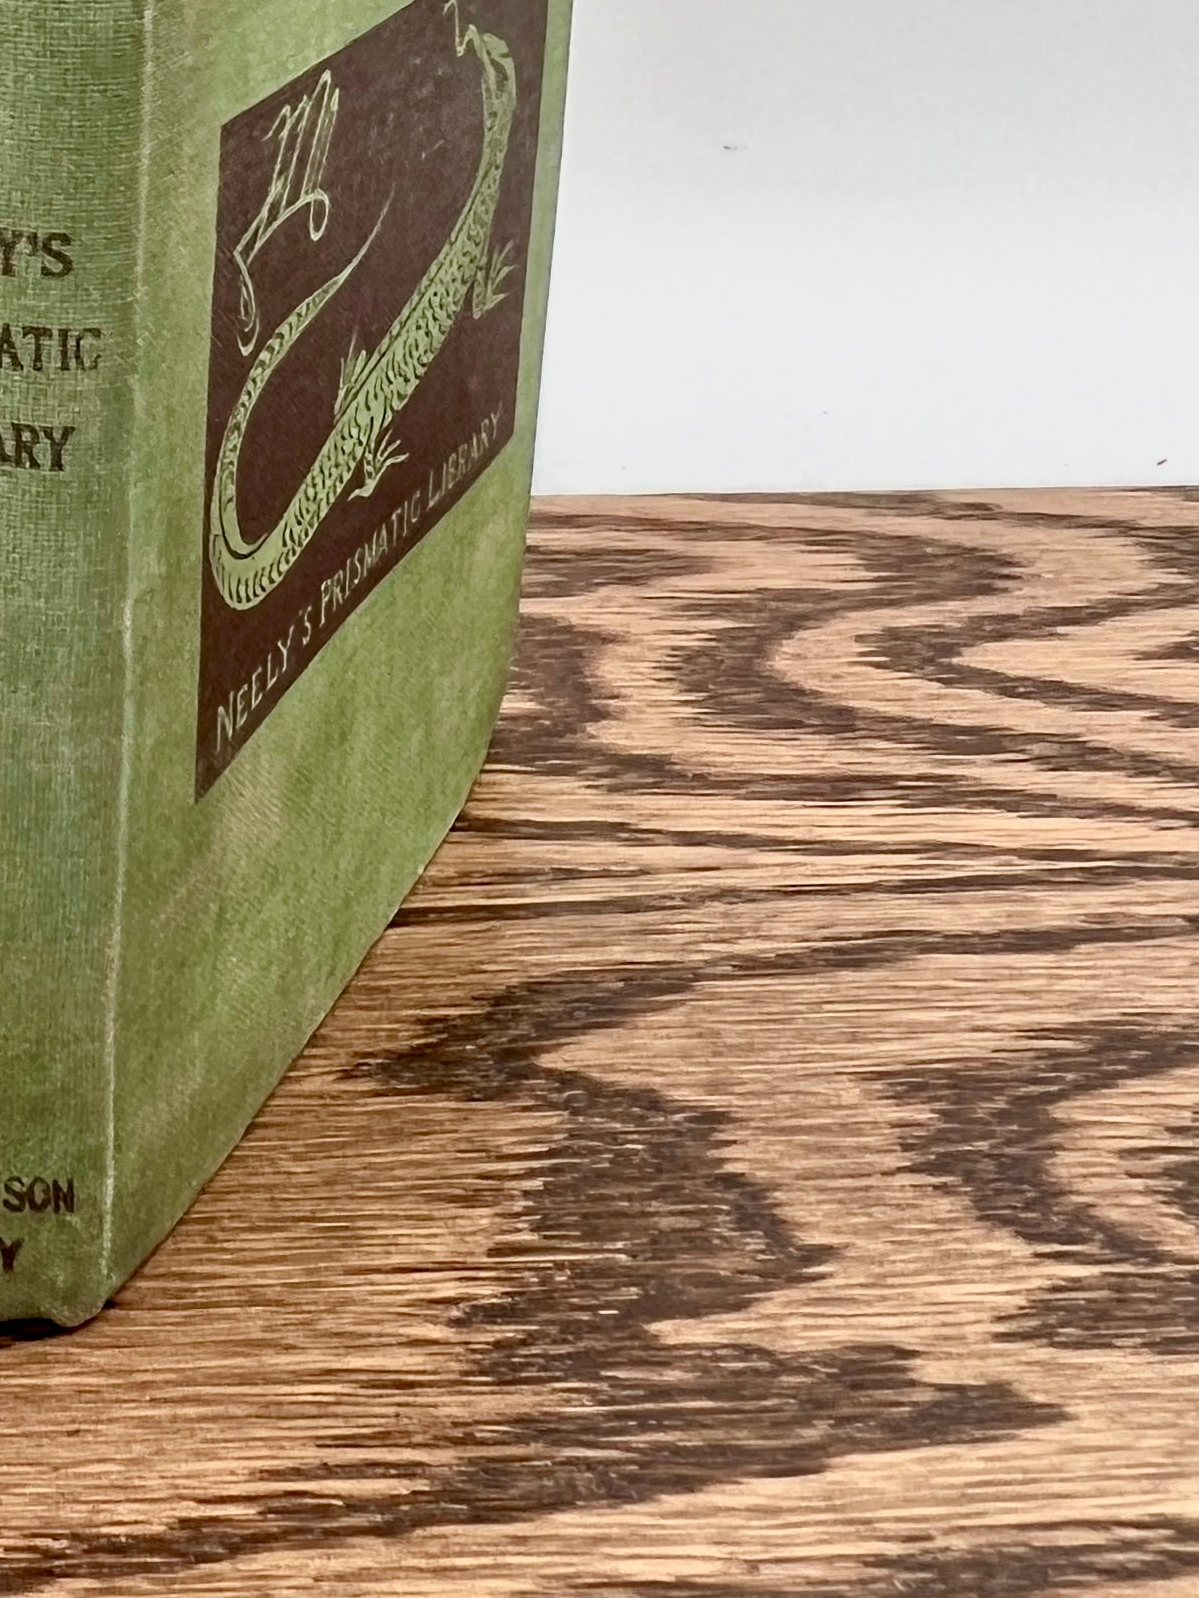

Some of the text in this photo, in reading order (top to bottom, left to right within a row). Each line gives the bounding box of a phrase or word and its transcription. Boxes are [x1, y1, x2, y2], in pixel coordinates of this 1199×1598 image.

[213, 404, 503, 754] NEELY'S PRISMATIC LIBRARY
